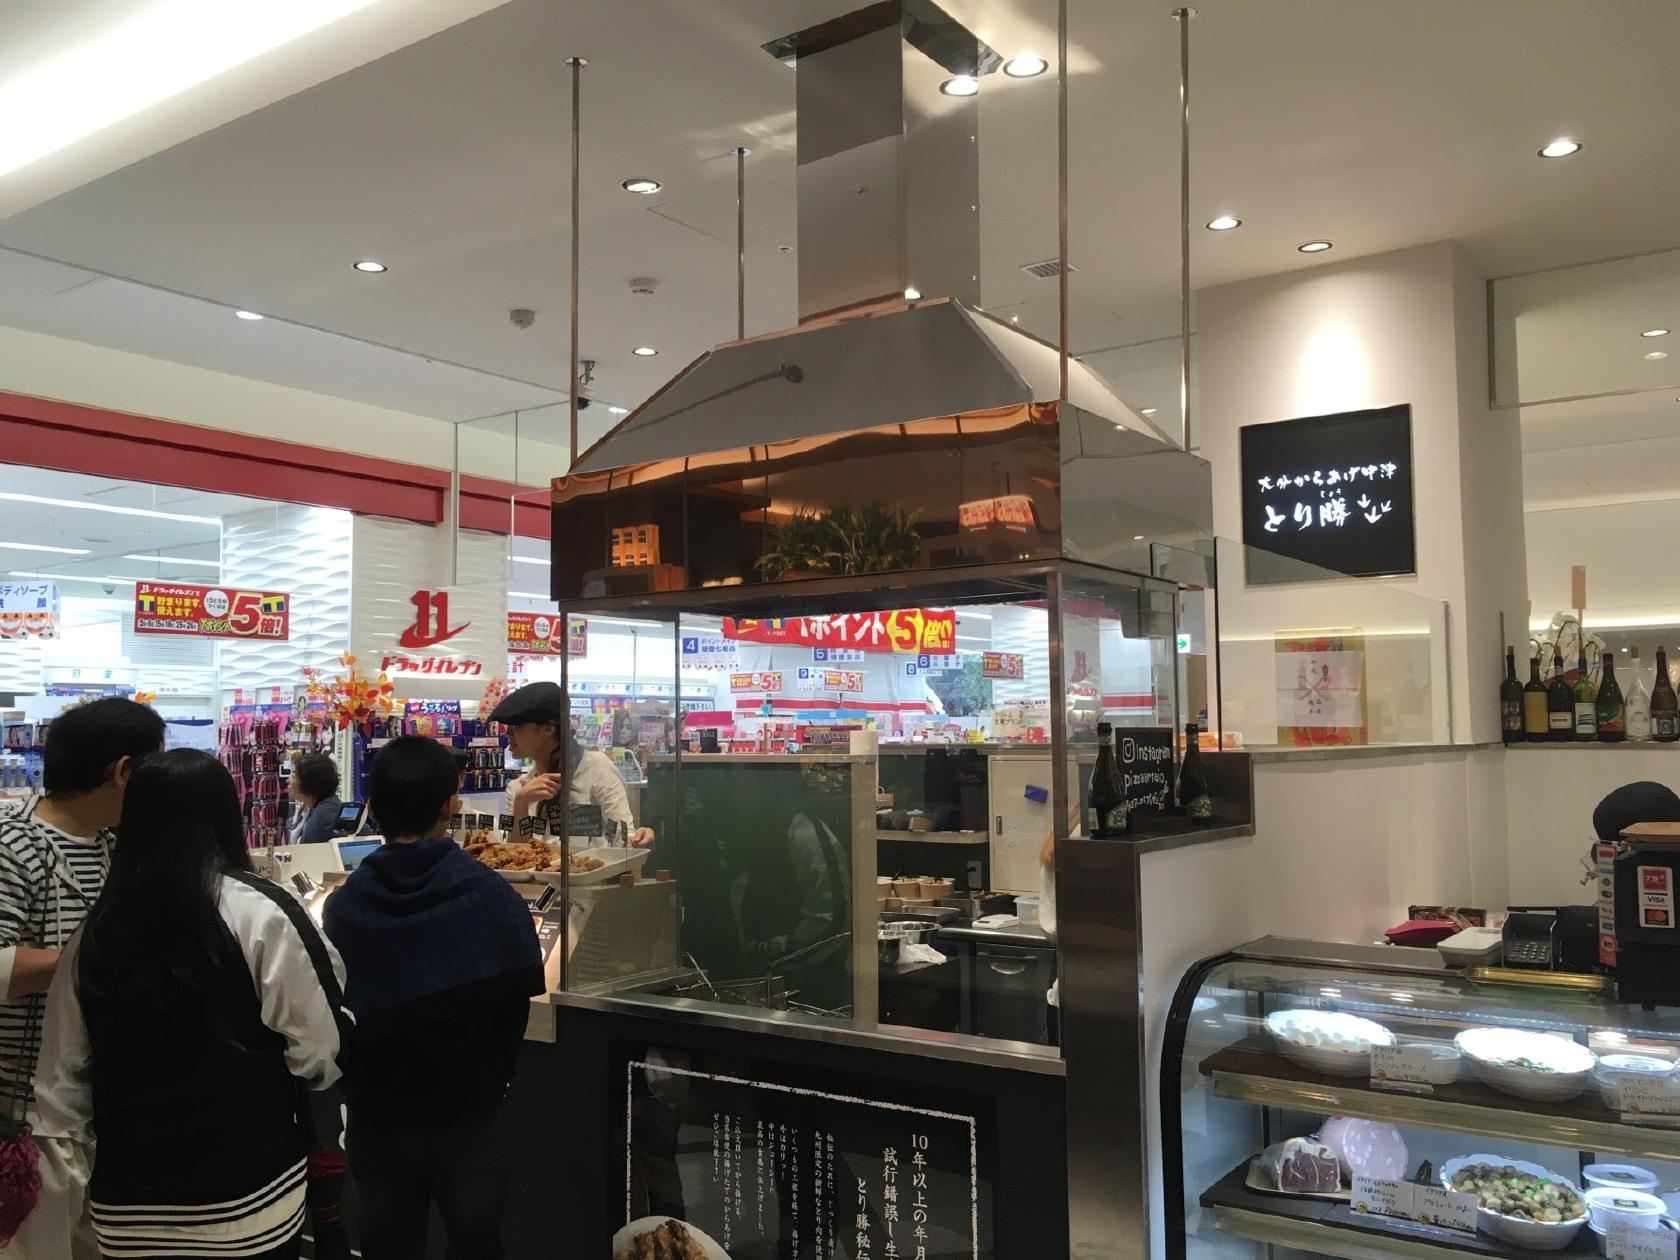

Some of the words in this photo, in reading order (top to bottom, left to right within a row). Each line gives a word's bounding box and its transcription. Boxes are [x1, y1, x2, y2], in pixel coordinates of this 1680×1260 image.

[1258, 462, 1397, 493] 大分からあげ中津
[1264, 497, 1351, 532] とり勝
[0, 585, 48, 596] ディソープ
[686, 639, 697, 652] 4
[816, 647, 826, 659] 5
[381, 655, 482, 676] ドラッグイレブン
[918, 653, 929, 667] 6
[799, 668, 808, 678] 9
[1136, 743, 1171, 765] Instagram
[1647, 896, 1666, 904] VISA
[882, 1147, 899, 1260] 試行錯誤し生
[911, 1133, 929, 1260] 10年以上の年月
